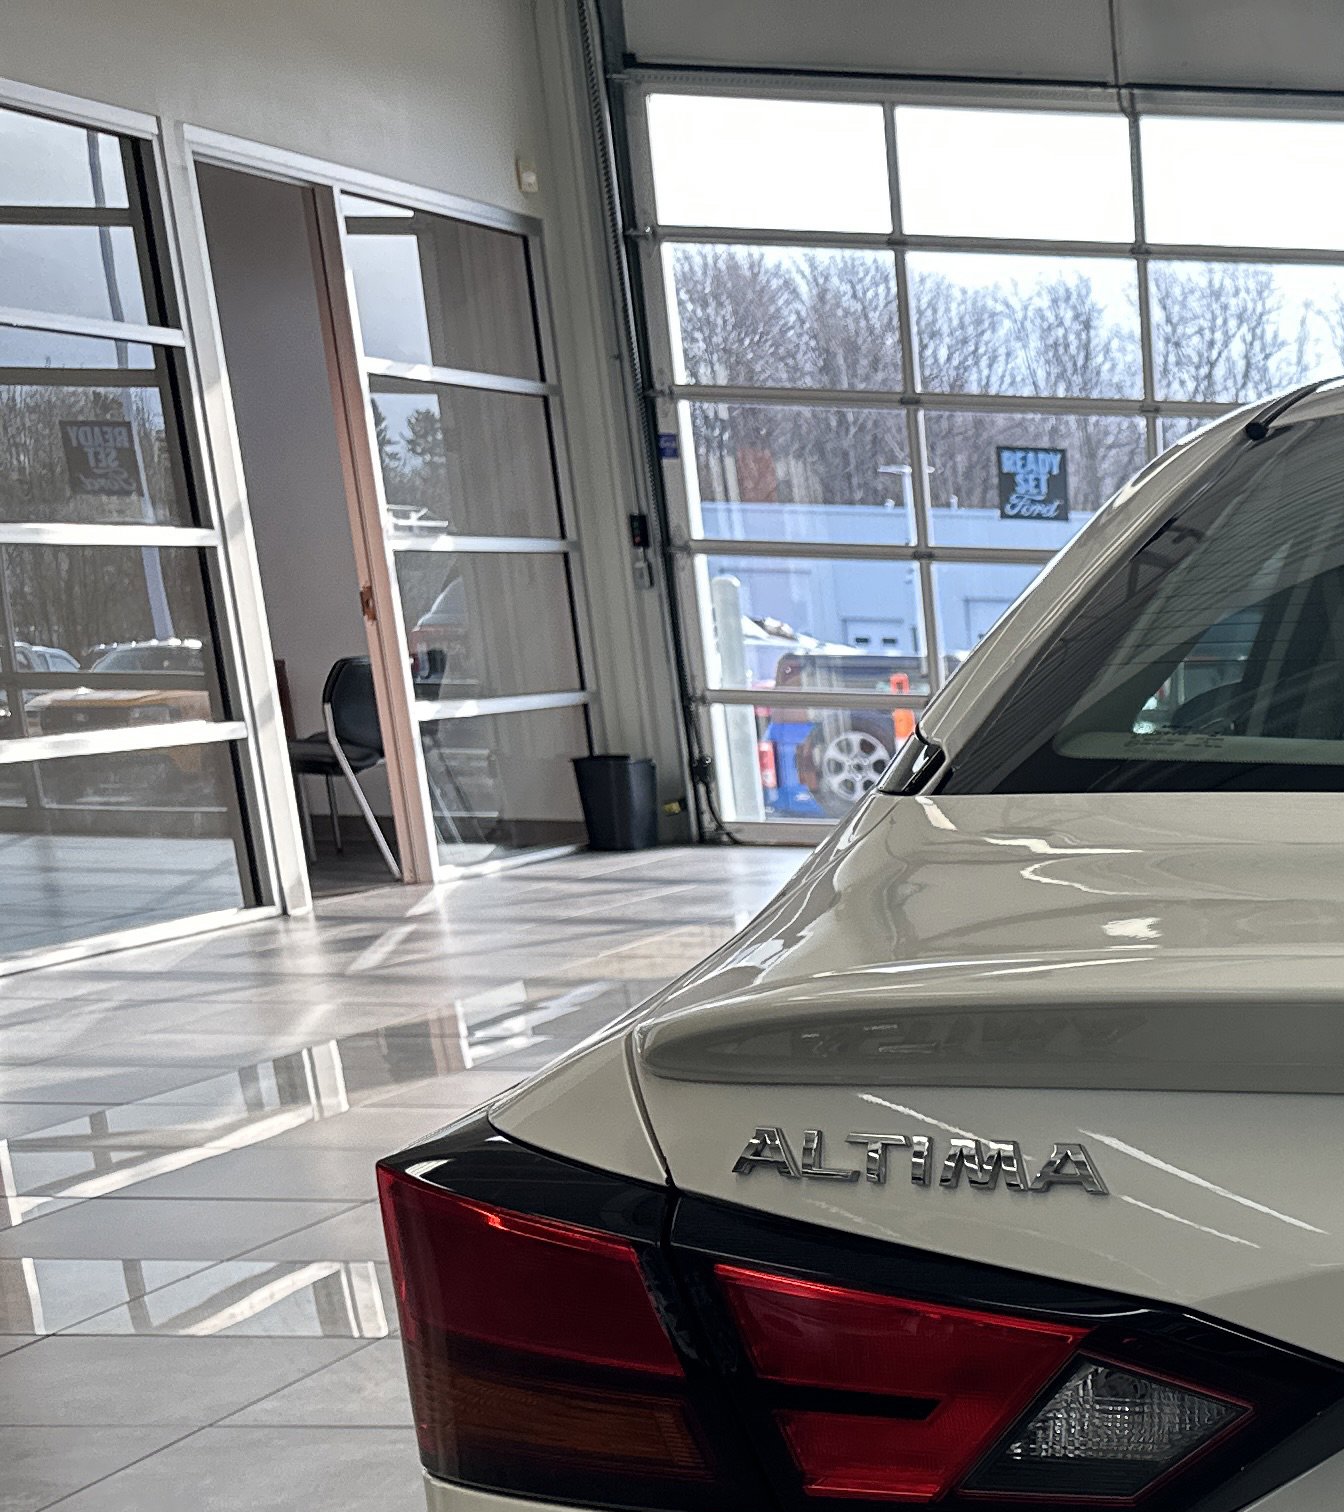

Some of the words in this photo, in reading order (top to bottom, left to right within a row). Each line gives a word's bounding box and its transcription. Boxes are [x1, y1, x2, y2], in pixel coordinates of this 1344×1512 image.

[1001, 450, 1061, 474] READY
[1015, 473, 1048, 495] SET
[1004, 494, 1062, 517] Ford
[731, 1126, 1109, 1194] ALTIMA
